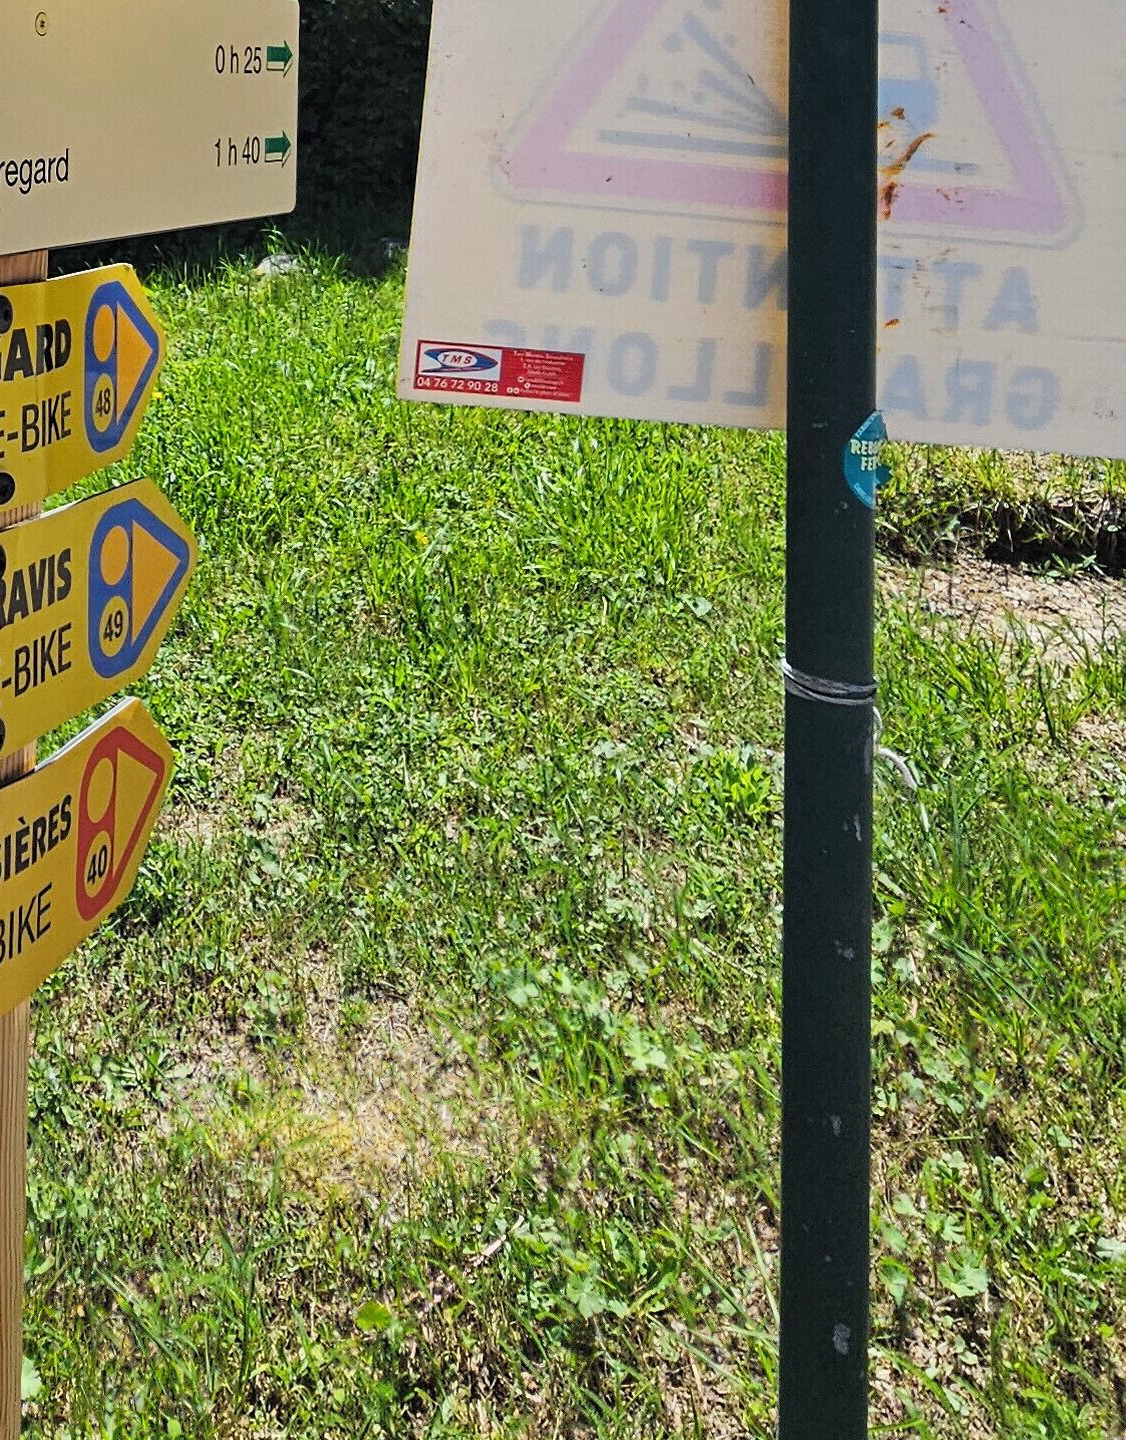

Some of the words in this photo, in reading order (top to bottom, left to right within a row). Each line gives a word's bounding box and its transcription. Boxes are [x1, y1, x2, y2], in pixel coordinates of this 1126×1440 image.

[440, 351, 473, 365] TMS
[417, 377, 431, 388] 04
[434, 378, 448, 389] 76
[450, 380, 465, 391] 72
[467, 381, 482, 392] 90
[484, 383, 499, 394] 28
[94, 391, 112, 416] 48
[102, 609, 124, 641] 49
[86, 844, 109, 885] 40
